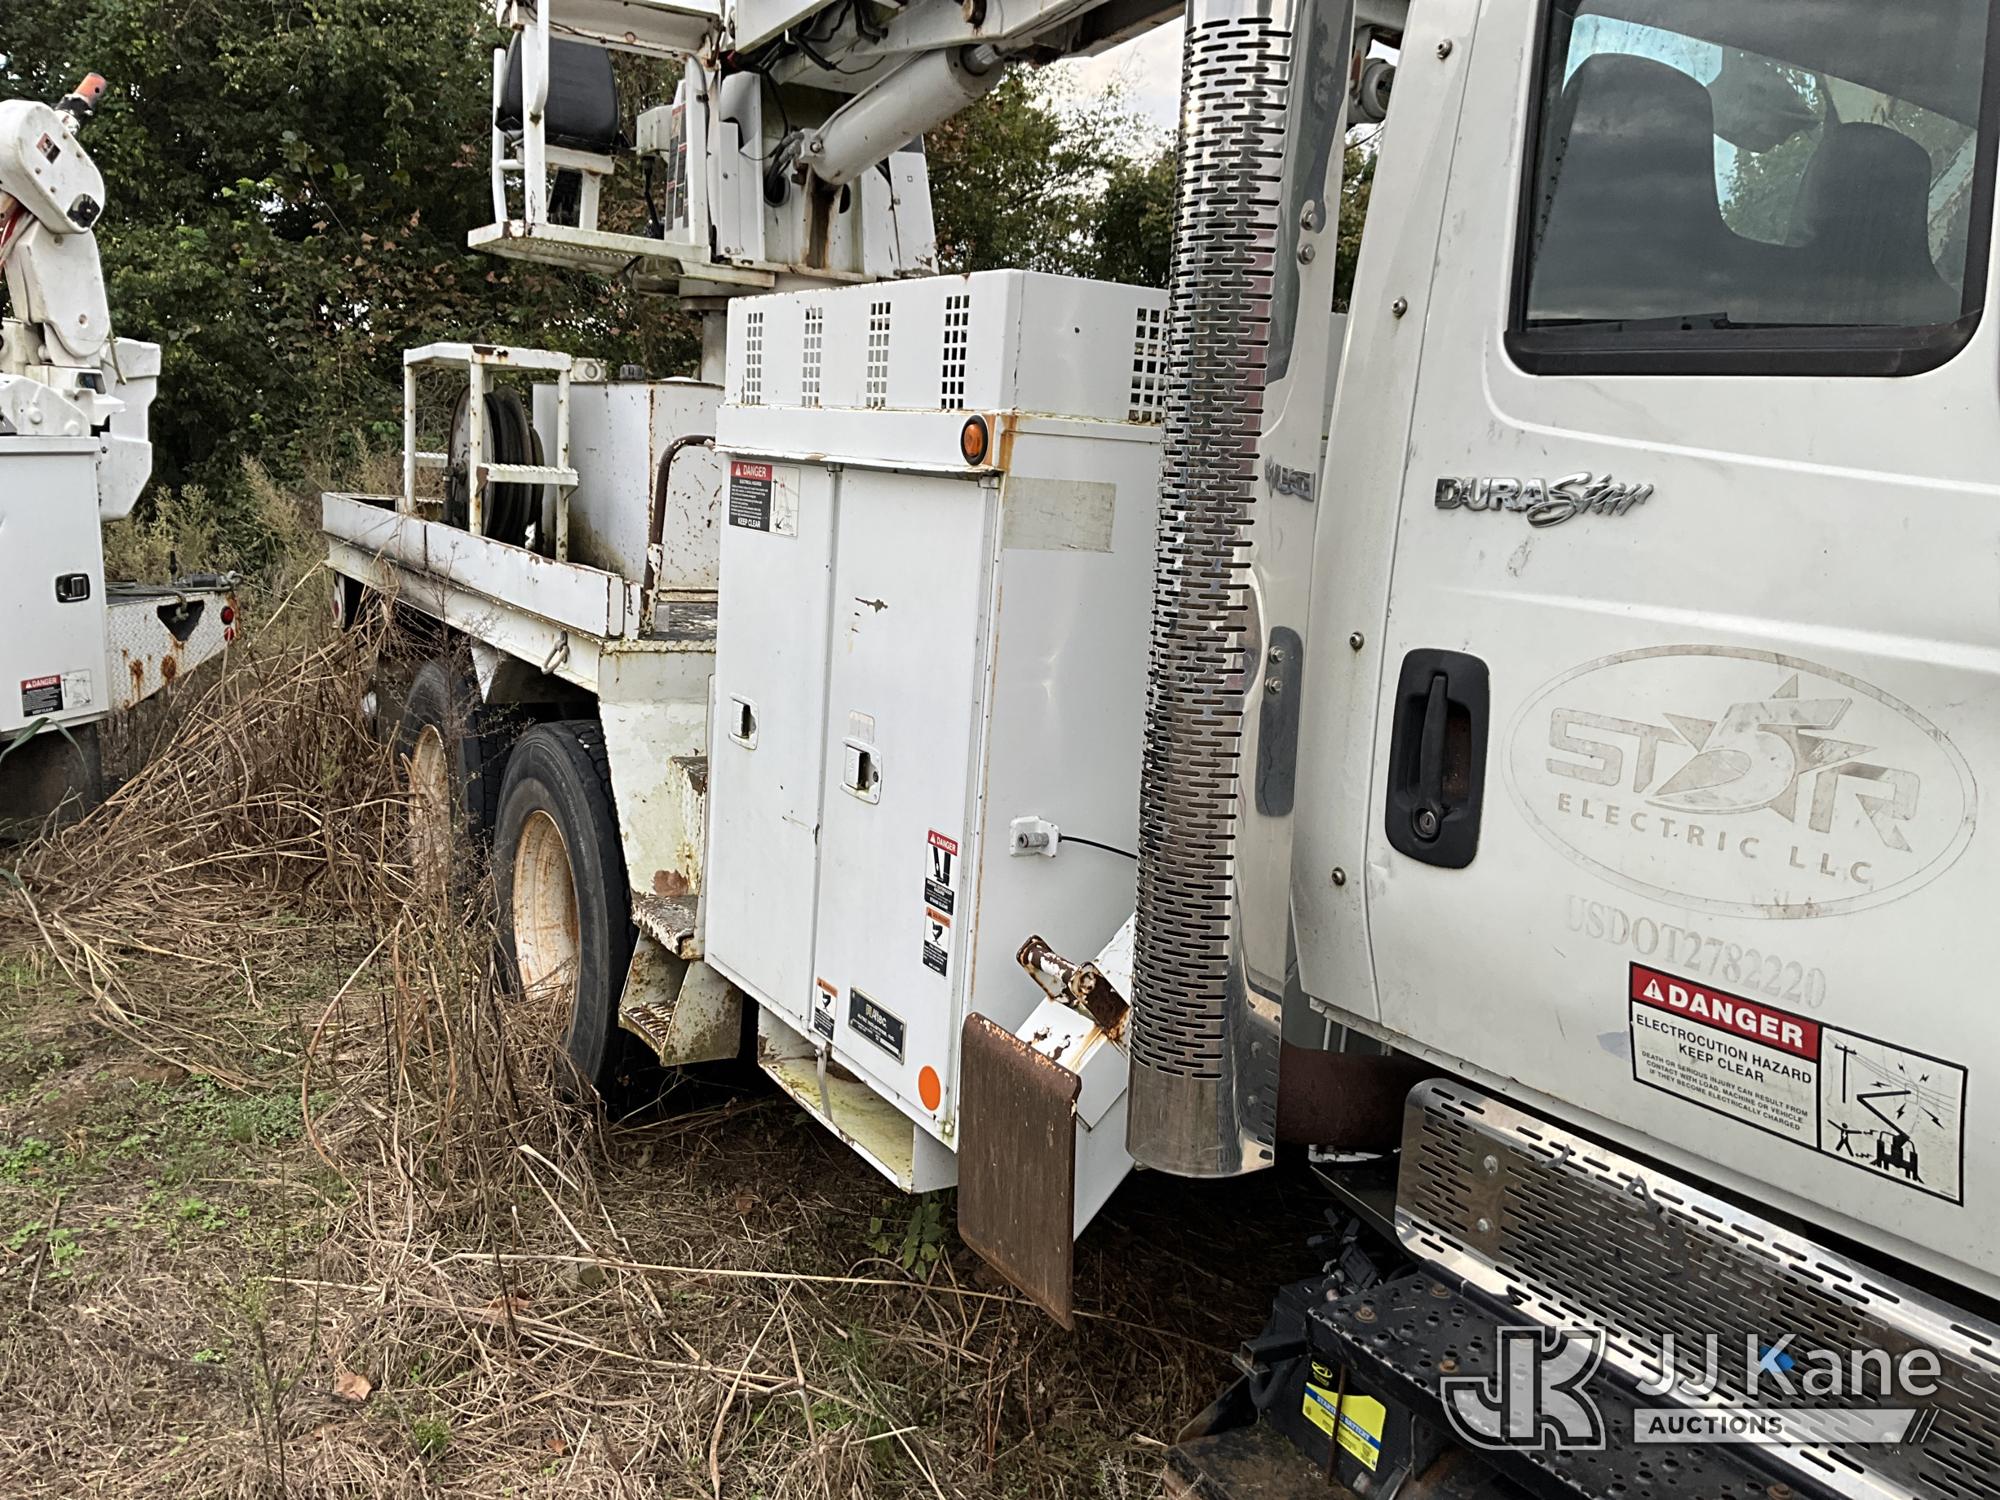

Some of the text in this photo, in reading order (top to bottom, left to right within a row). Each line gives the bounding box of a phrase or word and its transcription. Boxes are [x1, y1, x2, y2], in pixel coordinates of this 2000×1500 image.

[743, 464, 767, 478] DANGER
[1557, 793, 1873, 884] ELECTRIC LLC
[1566, 895, 1826, 1009] USDOT2782220
[1636, 1014, 1812, 1084] ELECTROCUTION HAZARD
[1668, 984, 1804, 1049] DANGER
[1641, 1051, 1808, 1117] DEATH OR SERIOUS INJURY CAN RESULT FROM
[1646, 1060, 1678, 1077] CONTACT
[1679, 1071, 1697, 1084] WITH
[1722, 1088, 1756, 1106] MACHINE
[1757, 1101, 1769, 1111] OR
[1770, 1106, 1803, 1124] VEHICLE
[1679, 1043, 1764, 1083] KEEP CLEAR
[1657, 1071, 1675, 1083] THEY
[1676, 1079, 1706, 1096] BECOME
[1708, 1091, 1761, 1115] ELECTRICALLY
[1762, 1111, 1801, 1130] CHARGED
